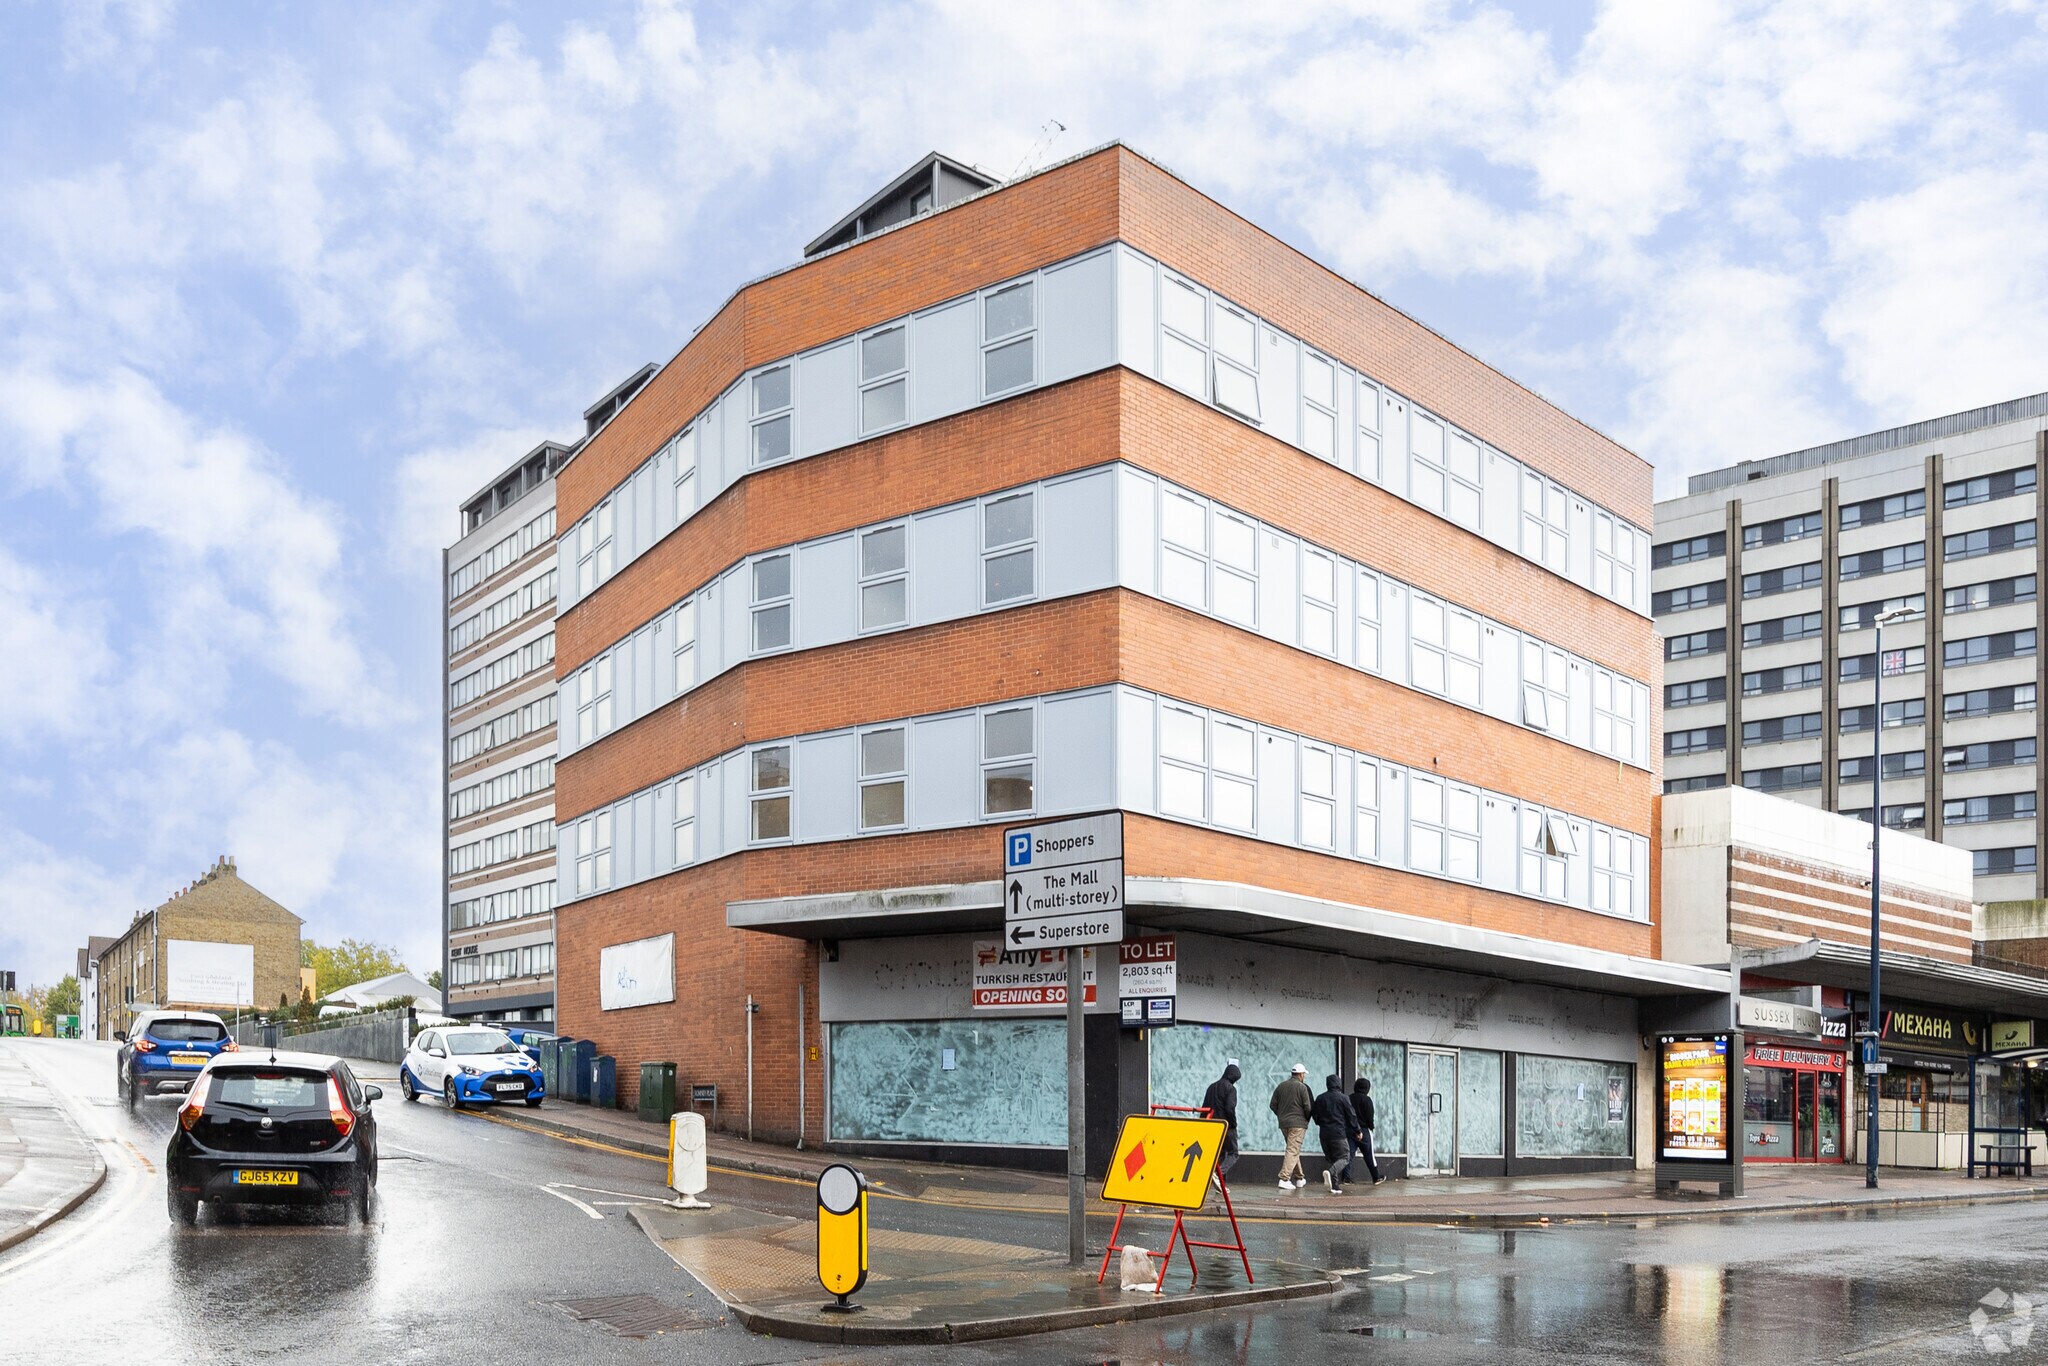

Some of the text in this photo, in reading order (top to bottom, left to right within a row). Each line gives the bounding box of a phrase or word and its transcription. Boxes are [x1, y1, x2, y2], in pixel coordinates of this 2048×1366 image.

[1035, 834, 1095, 853] Shoppers
[1043, 869, 1098, 889] The Mall
[1026, 885, 1118, 911] (multi-storey)
[1039, 922, 1110, 940] Superstore
[1120, 942, 1174, 959] TO LET
[976, 971, 1094, 985] TURKISH RESTAUT
[1122, 964, 1173, 977] 2,803 sq.ft
[980, 986, 1087, 1003] OPENING SO
[1754, 1007, 1790, 1024] SUSSEX
[1703, 1055, 1725, 1064] TASTE
[1754, 1048, 1831, 1066] FREE DELIVERY
[1749, 1133, 1779, 1144] Tops Pizza
[240, 1171, 294, 1182] GJ65 KZV
